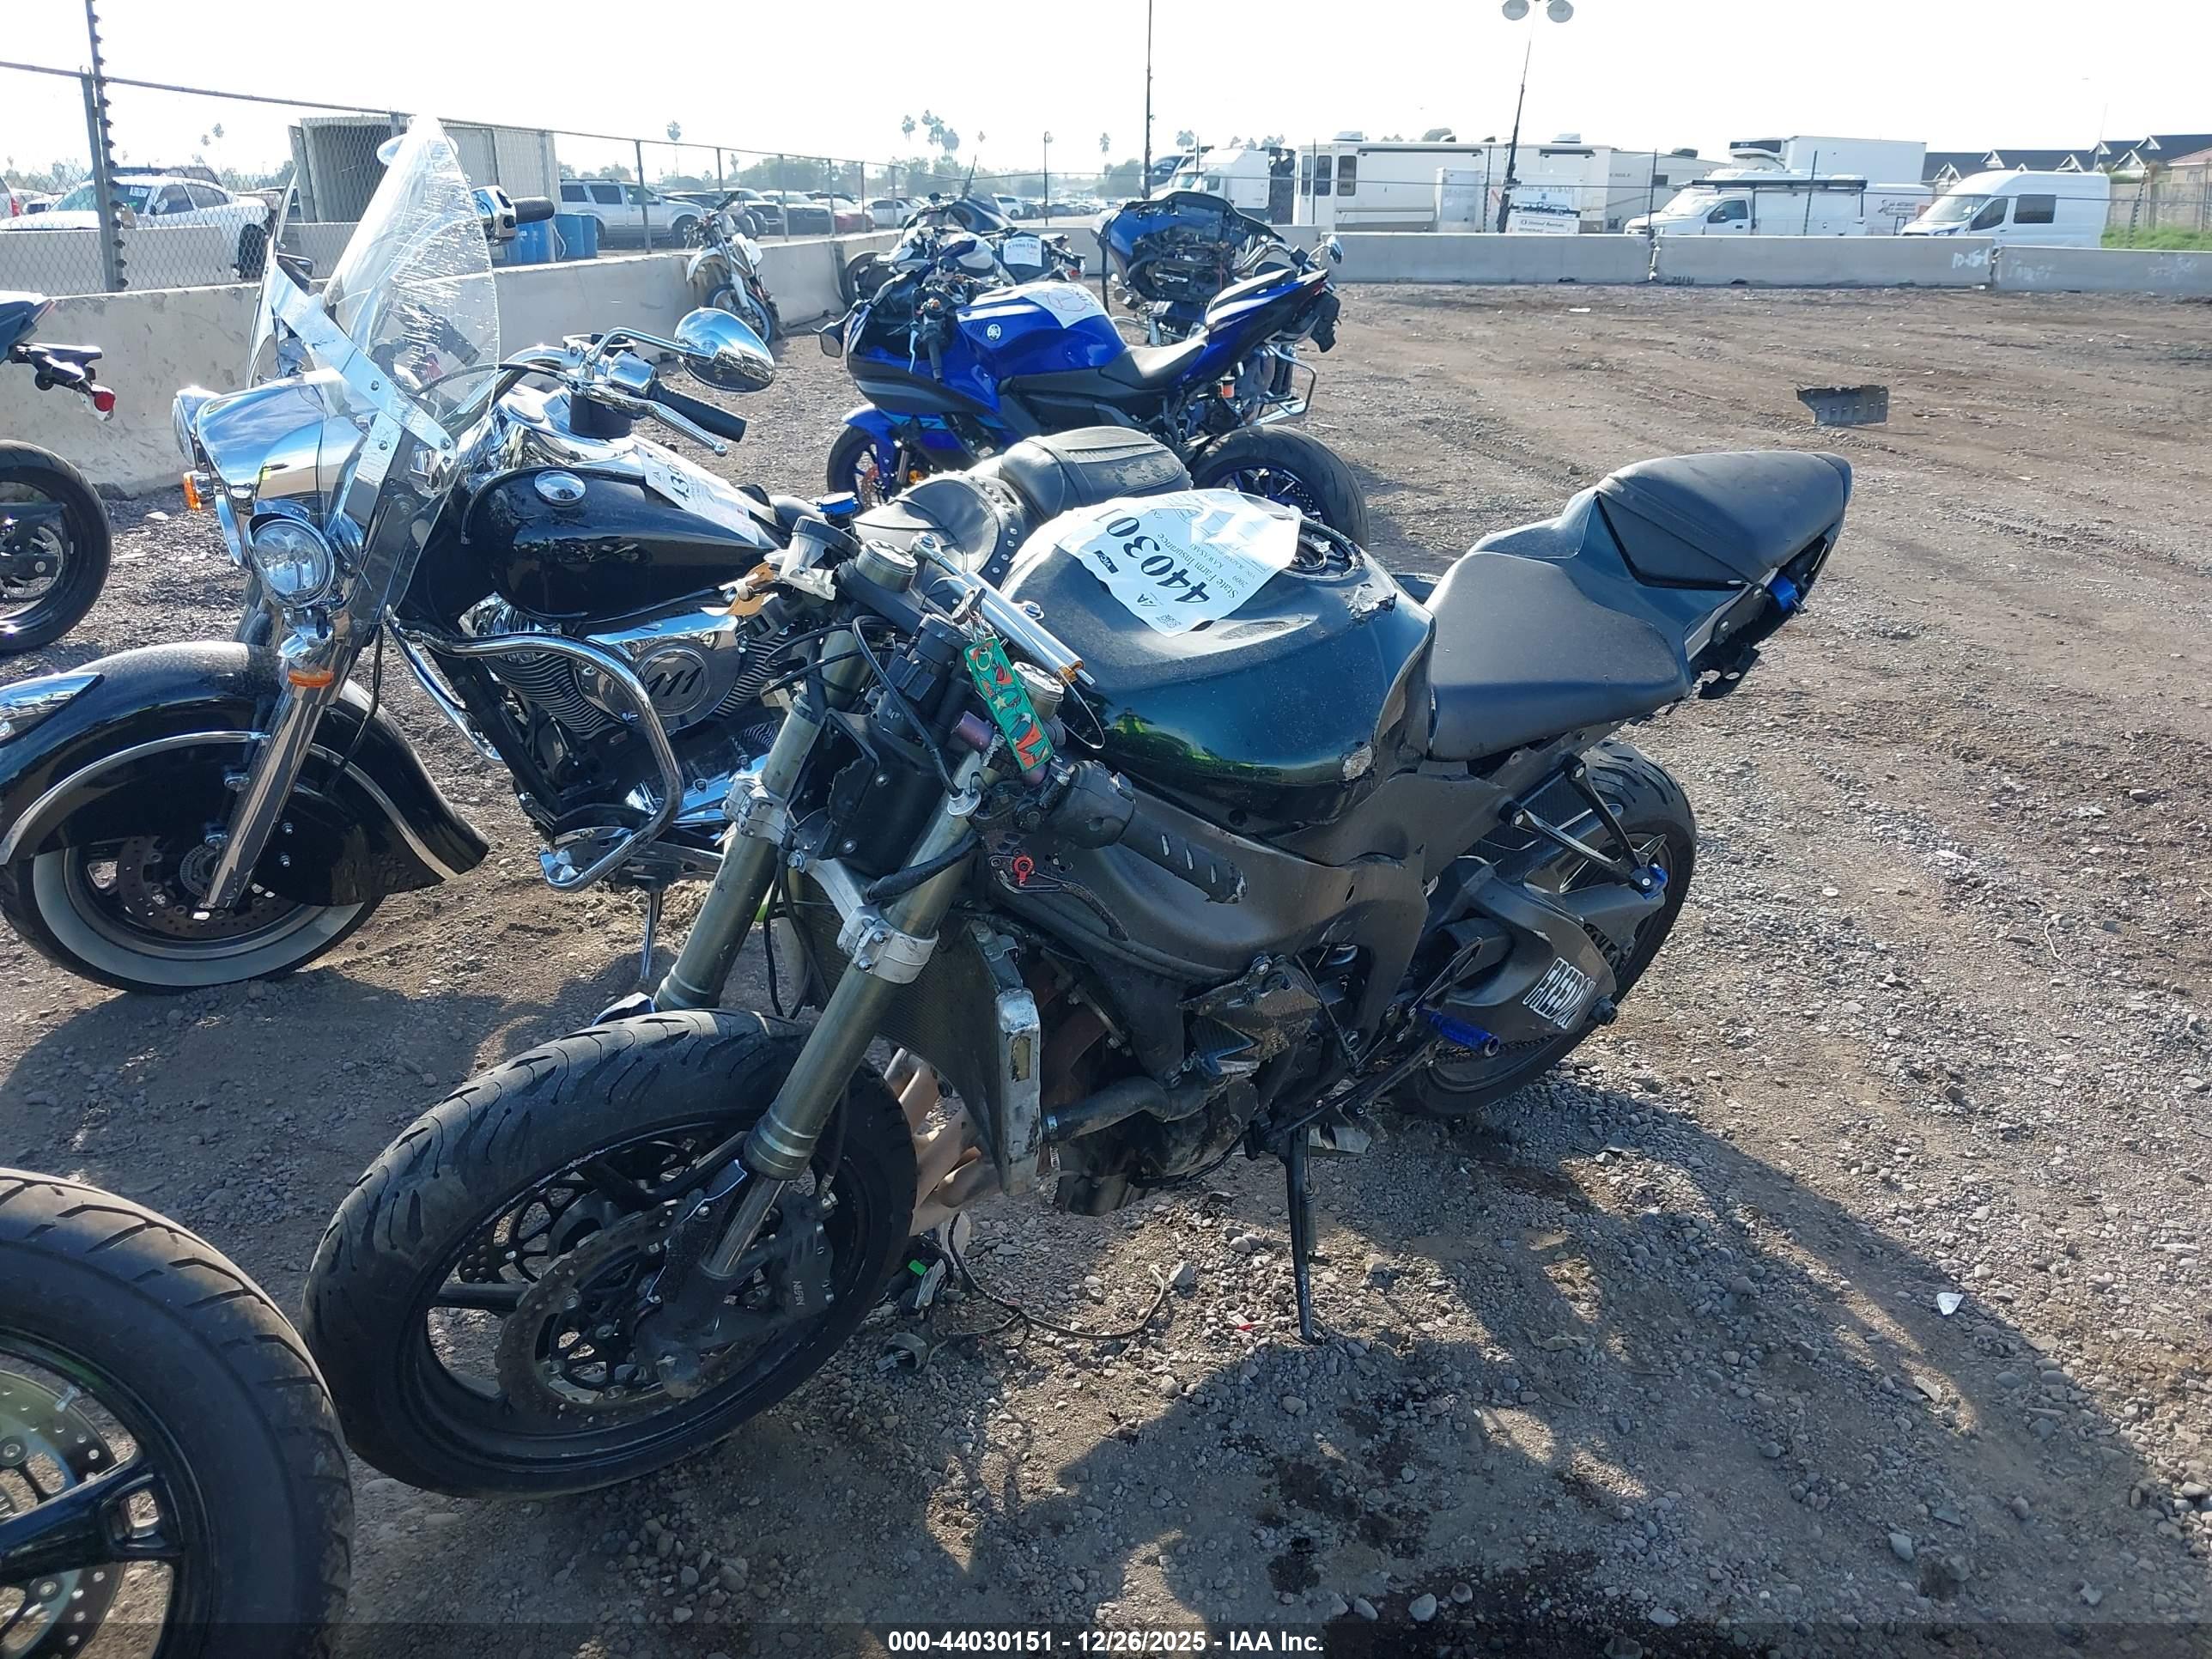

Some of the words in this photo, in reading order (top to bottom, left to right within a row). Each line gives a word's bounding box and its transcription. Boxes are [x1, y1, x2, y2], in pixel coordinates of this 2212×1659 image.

[1158, 532, 1195, 567] Insurance
[1189, 543, 1224, 569] KAWASAKI
[1194, 562, 1217, 582] Farm
[1215, 578, 1239, 599] State
